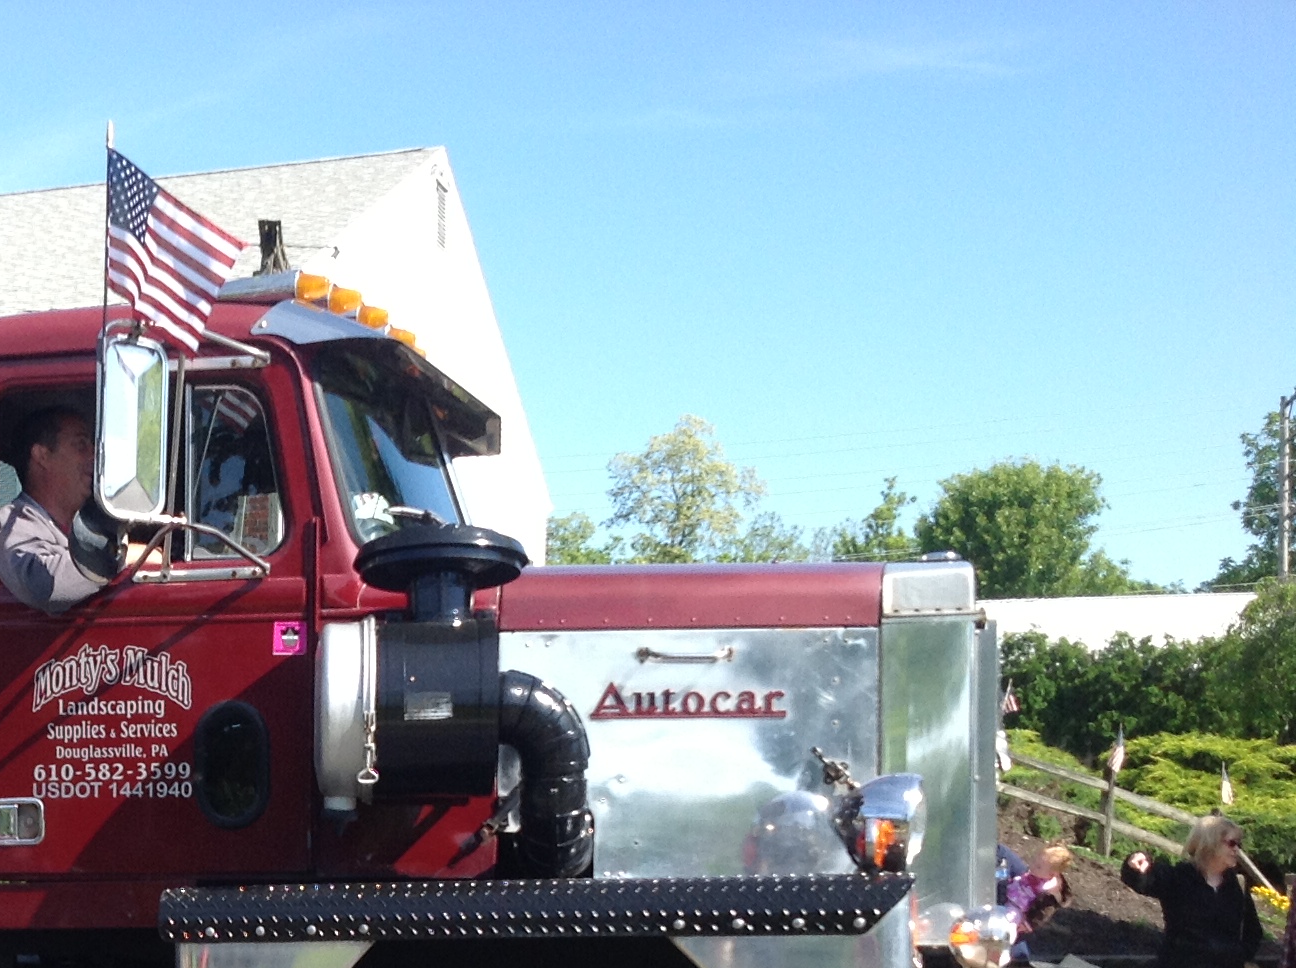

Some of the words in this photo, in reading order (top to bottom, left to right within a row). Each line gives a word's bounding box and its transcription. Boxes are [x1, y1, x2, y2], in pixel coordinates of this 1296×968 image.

[32, 643, 119, 712] Monty's
[121, 645, 192, 710] Mulch
[58, 696, 165, 718] Landscaping
[590, 682, 787, 719] Autocar
[47, 720, 106, 743] Supplies
[109, 728, 117, 739] &
[120, 719, 178, 738] Services
[56, 743, 147, 761] Douglassville,
[151, 743, 169, 758] PA
[33, 761, 191, 781] 610-582-3599
[32, 781, 103, 798] USDOT
[108, 781, 193, 798] 1441940
